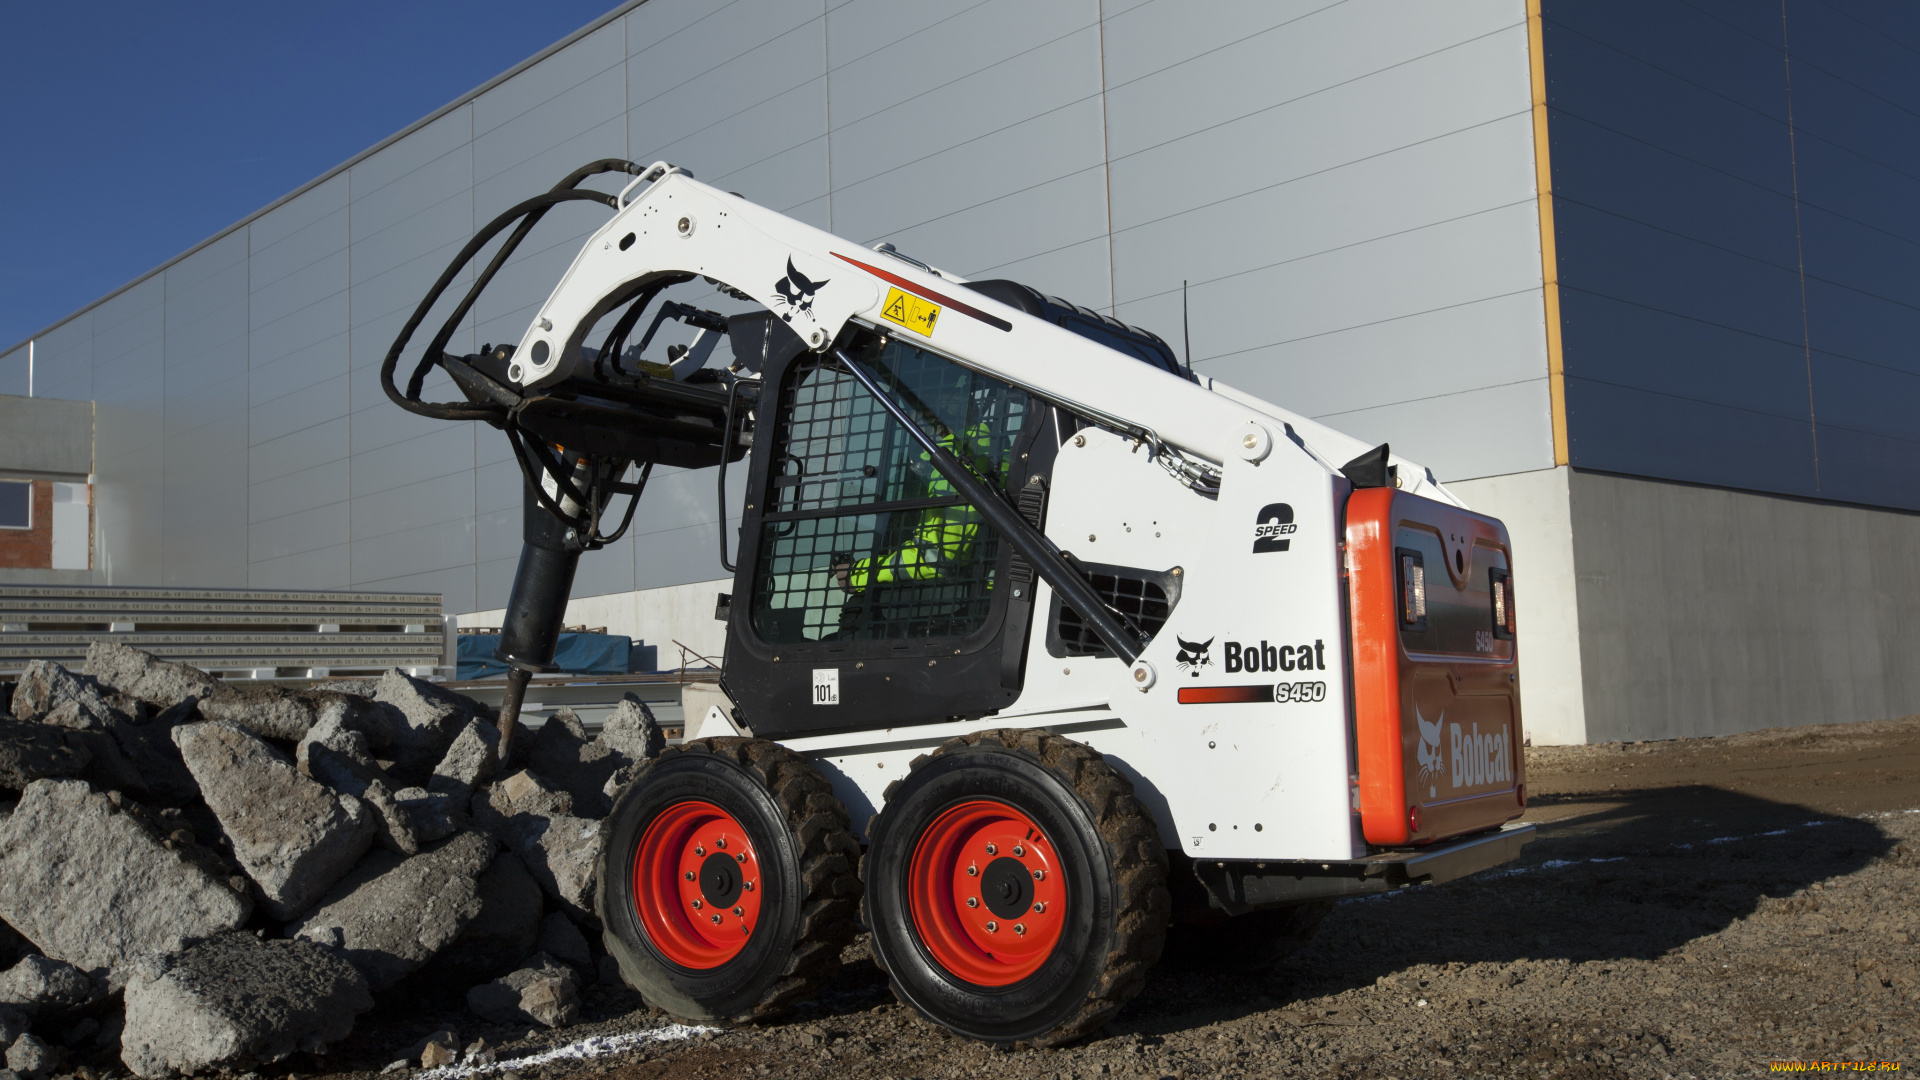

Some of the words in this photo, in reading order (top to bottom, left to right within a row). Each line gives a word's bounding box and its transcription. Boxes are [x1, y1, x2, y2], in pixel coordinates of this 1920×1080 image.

[1252, 502, 1294, 554] 2
[1255, 524, 1298, 536] SPEED
[1476, 630, 1494, 652] S450
[1224, 639, 1326, 673] Bobcat
[815, 684, 830, 702] 101
[1276, 681, 1326, 703] S450
[1450, 722, 1510, 788] Bobcat
